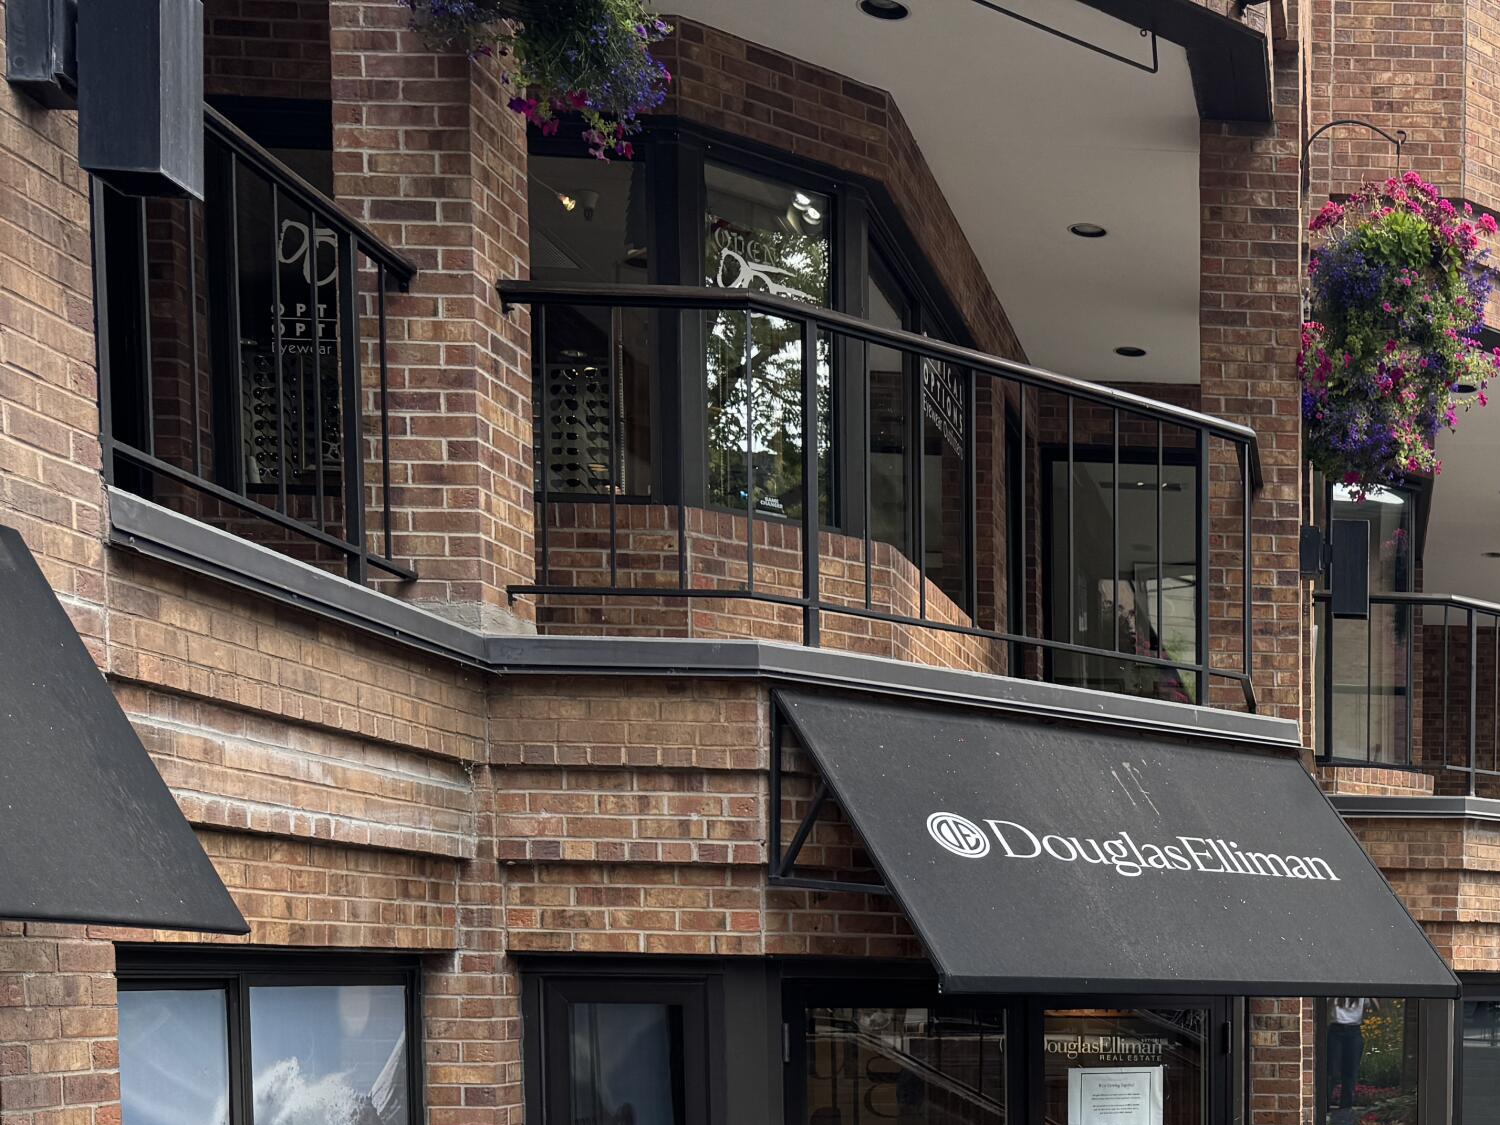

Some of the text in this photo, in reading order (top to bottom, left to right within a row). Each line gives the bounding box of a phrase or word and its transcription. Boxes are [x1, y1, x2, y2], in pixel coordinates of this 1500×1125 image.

[923, 363, 963, 435] OPTIONS
[982, 818, 1341, 881] DouglasElliman
[1044, 1036, 1163, 1060] ouglasElliman
